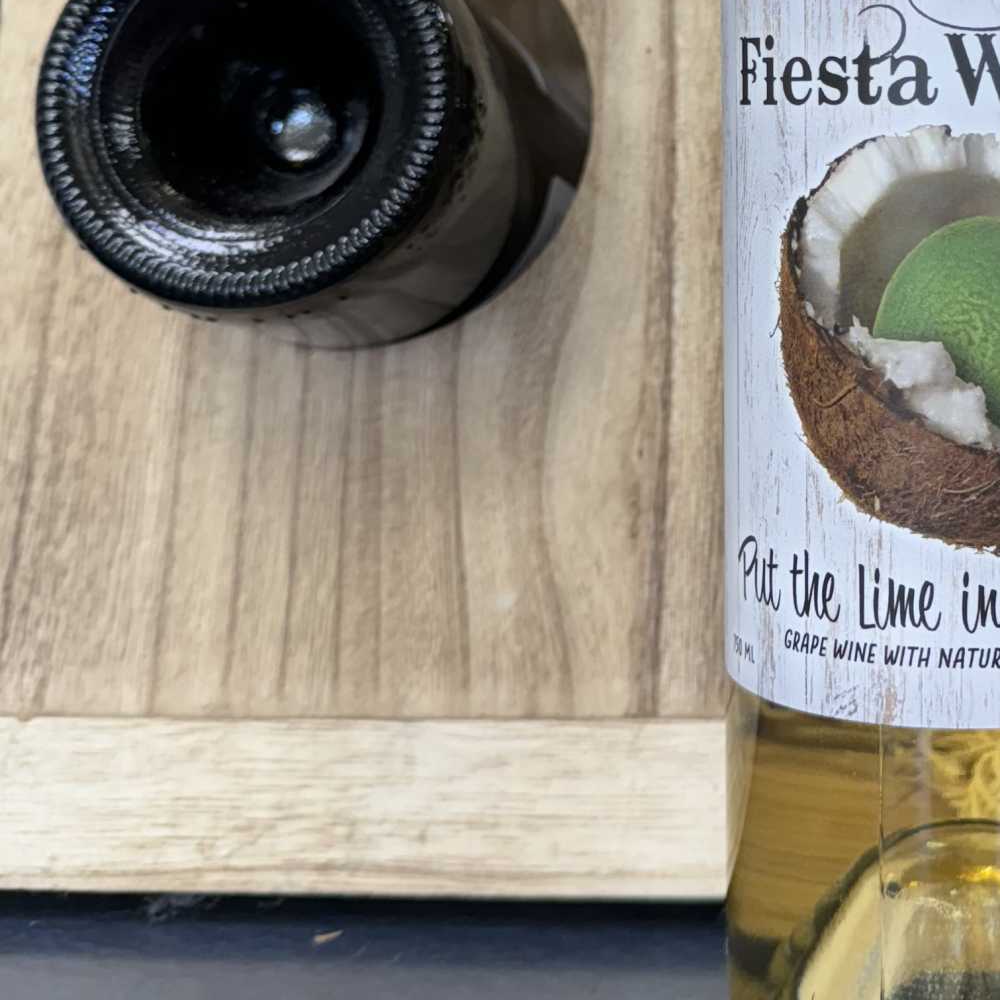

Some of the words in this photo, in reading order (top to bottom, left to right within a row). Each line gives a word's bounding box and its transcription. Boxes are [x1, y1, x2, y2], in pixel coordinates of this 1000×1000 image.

[739, 4, 938, 106] Fiesta
[738, 535, 782, 612] Put
[789, 549, 841, 623] the
[858, 563, 942, 632] Lime
[784, 628, 829, 657] GRAPE
[833, 638, 878, 664] WINE
[883, 644, 932, 669] WITH
